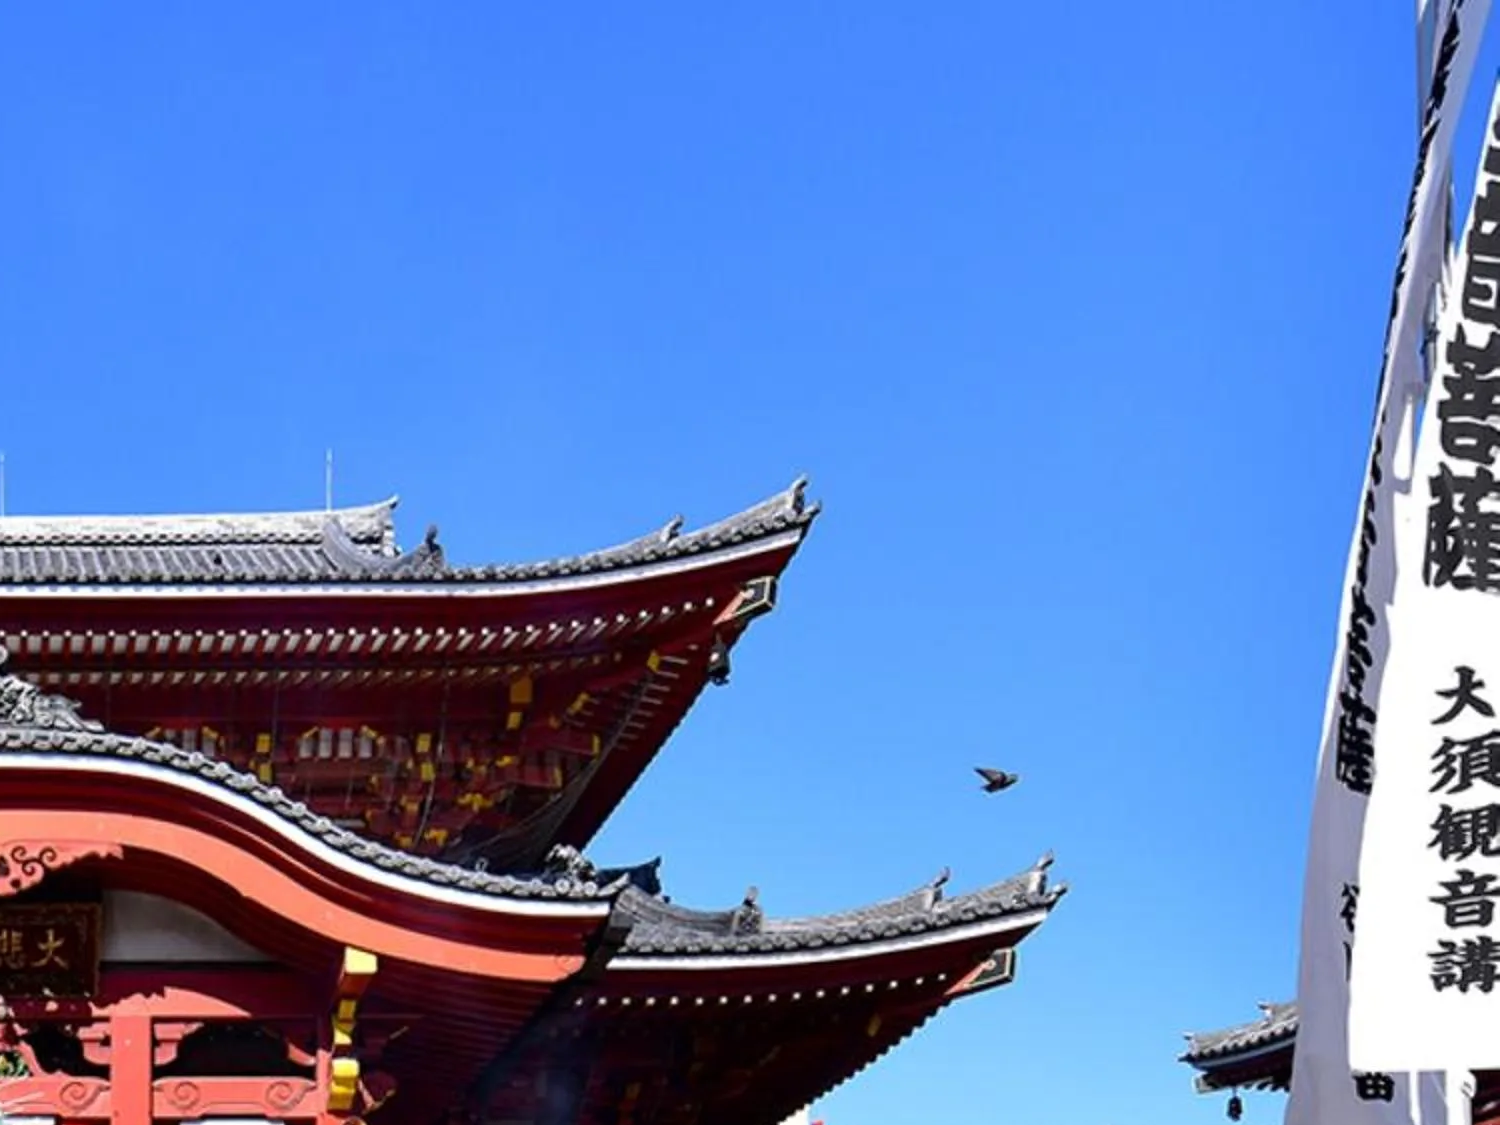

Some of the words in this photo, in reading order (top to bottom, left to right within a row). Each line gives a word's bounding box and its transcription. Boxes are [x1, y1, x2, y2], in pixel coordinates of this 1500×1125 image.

[1427, 665, 1500, 993] 大須観音講
